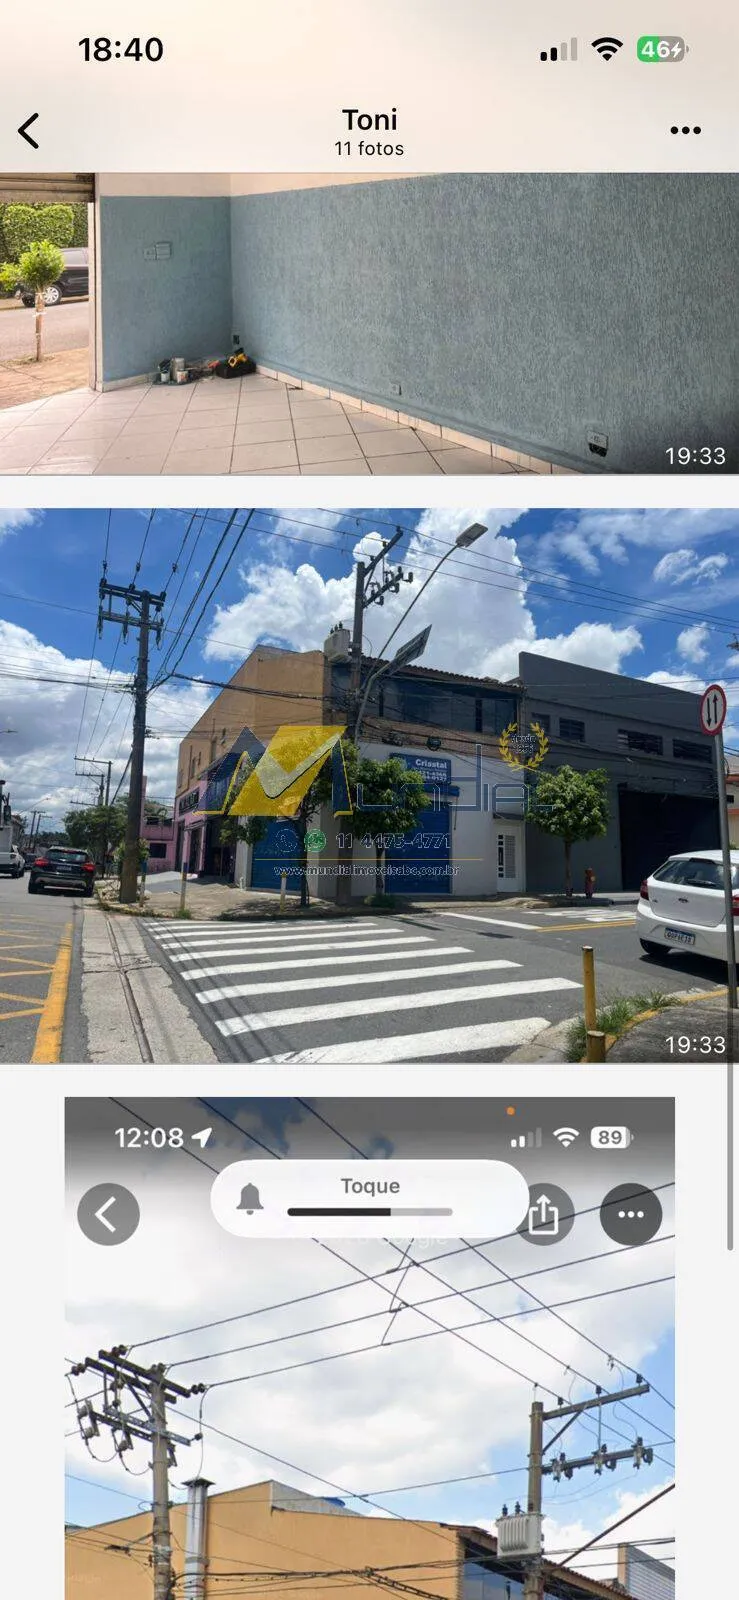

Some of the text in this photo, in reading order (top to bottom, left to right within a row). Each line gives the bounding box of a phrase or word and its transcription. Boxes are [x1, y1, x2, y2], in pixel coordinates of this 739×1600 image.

[79, 37, 163, 61] 18:40
[641, 41, 669, 58] 46
[342, 107, 397, 131] Toni
[335, 140, 404, 156] 11 fotos
[665, 447, 726, 465] 19:33
[665, 1036, 726, 1054] 19:33
[115, 1127, 184, 1148] 12:08
[598, 1130, 622, 1145] 89
[340, 1177, 400, 1197] Toque
